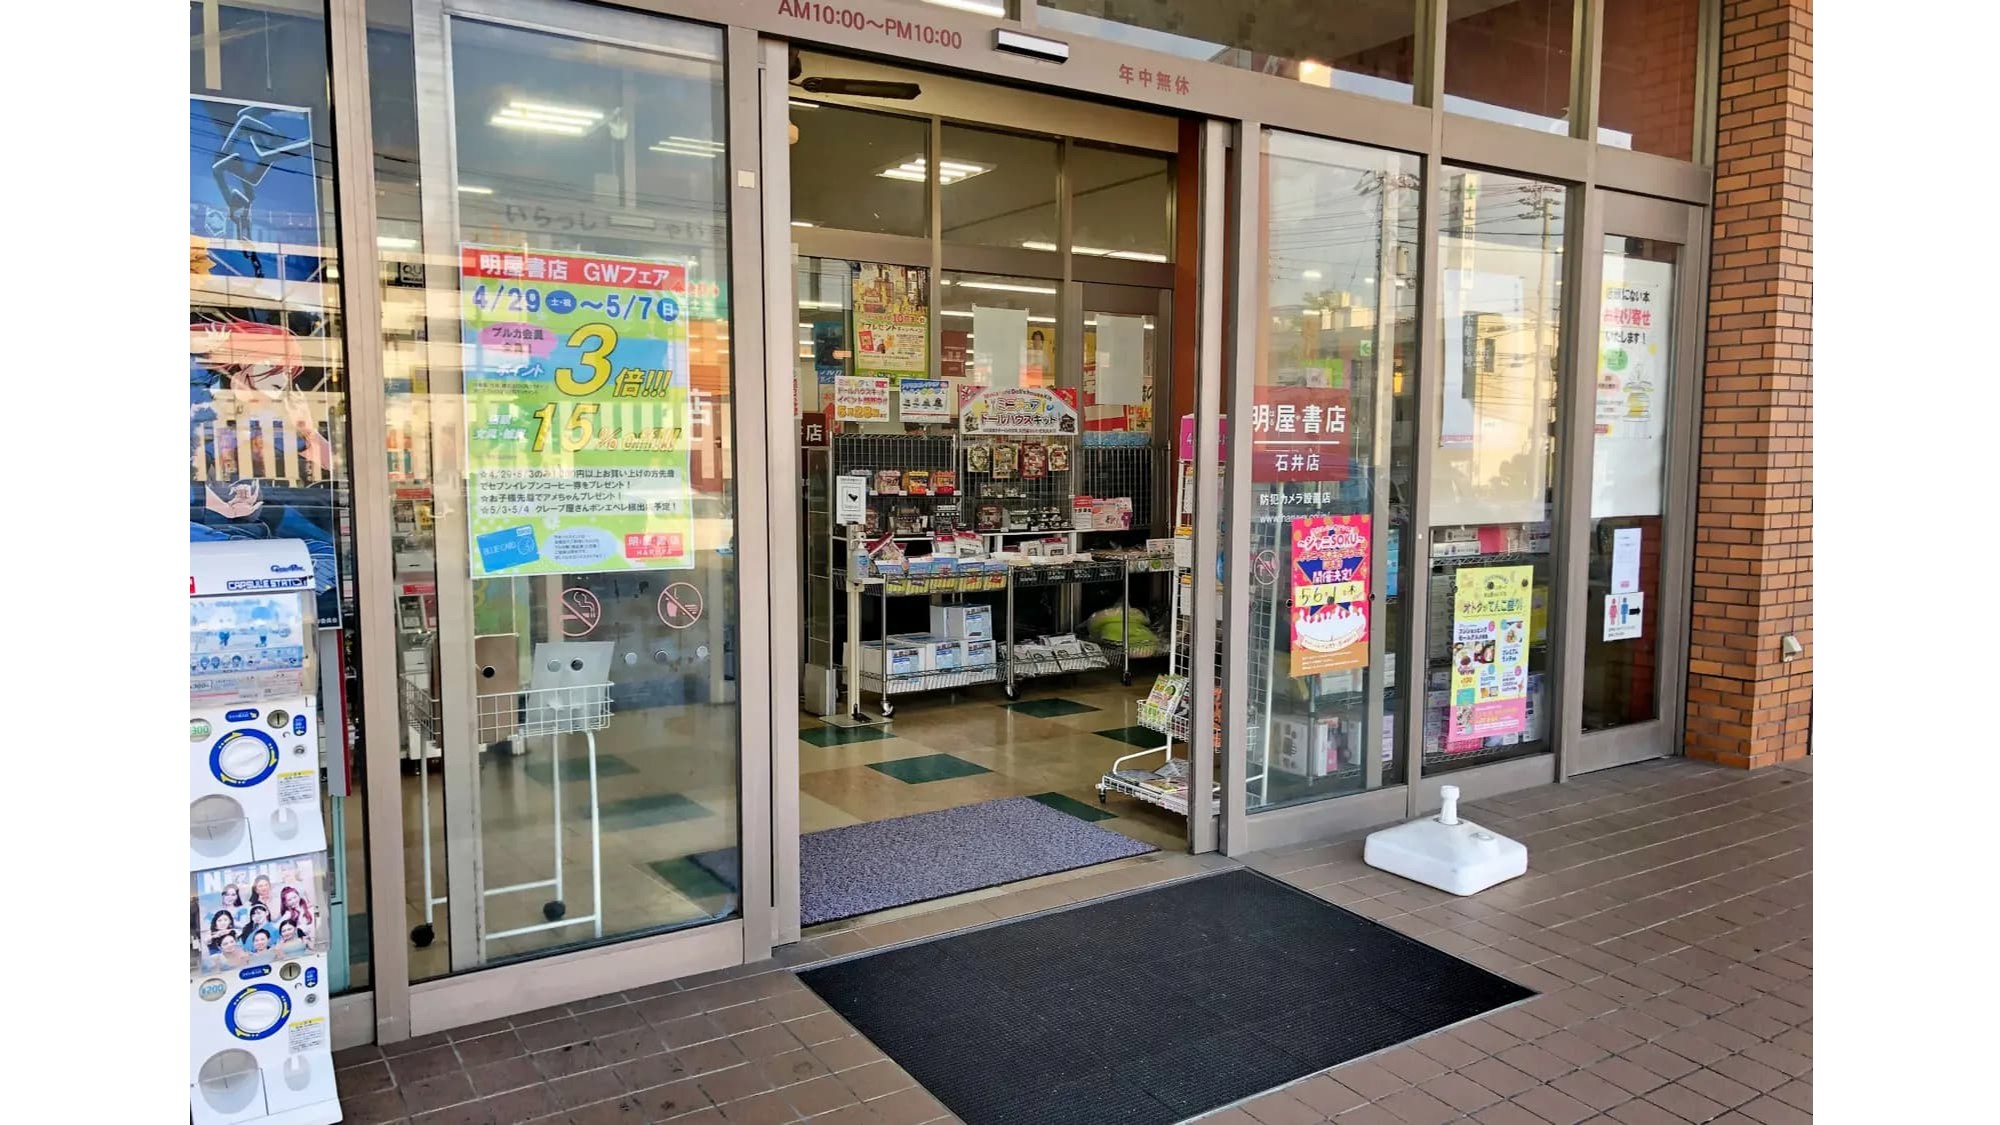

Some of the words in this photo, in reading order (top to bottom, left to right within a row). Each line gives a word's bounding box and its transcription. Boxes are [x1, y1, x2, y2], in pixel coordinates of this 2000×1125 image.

[1118, 63, 1190, 95] 年中無休
[480, 254, 568, 281] 明屋書店
[583, 262, 671, 286] GWフェア
[661, 302, 674, 318] 日
[554, 322, 618, 397] 3
[1252, 404, 1347, 434] 明屋書店
[1275, 453, 1320, 473] 石井店
[1260, 491, 1332, 506] 防犯カメラ設置店
